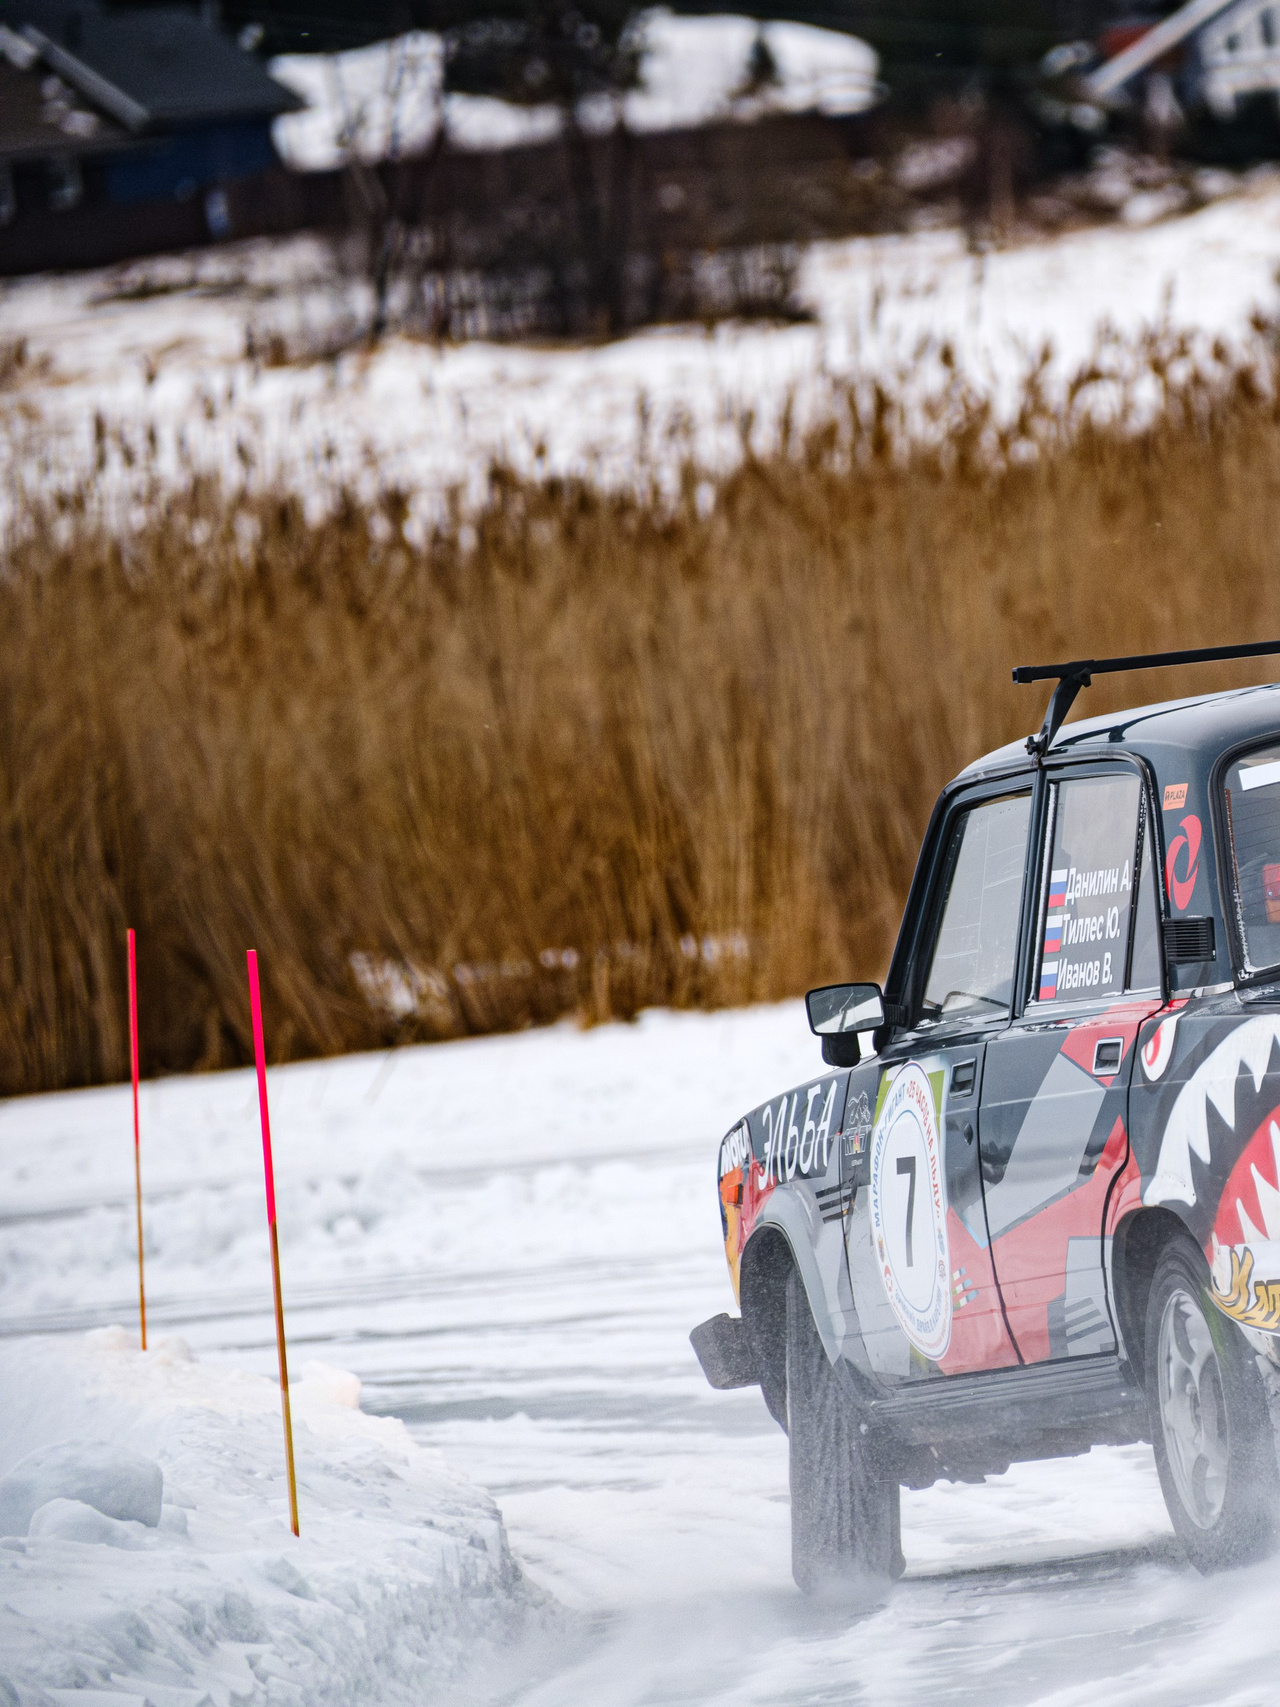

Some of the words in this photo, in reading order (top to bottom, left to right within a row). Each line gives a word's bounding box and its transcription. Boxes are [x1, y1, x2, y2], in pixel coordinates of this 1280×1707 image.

[1064, 867, 1120, 906] Данилин
[1120, 859, 1132, 892] А.
[1062, 913, 1104, 945] Тиллес
[1105, 906, 1120, 940] Ю.
[1056, 957, 1101, 991] Иванов
[1101, 951, 1113, 985] В.
[896, 1155, 916, 1268] 7
